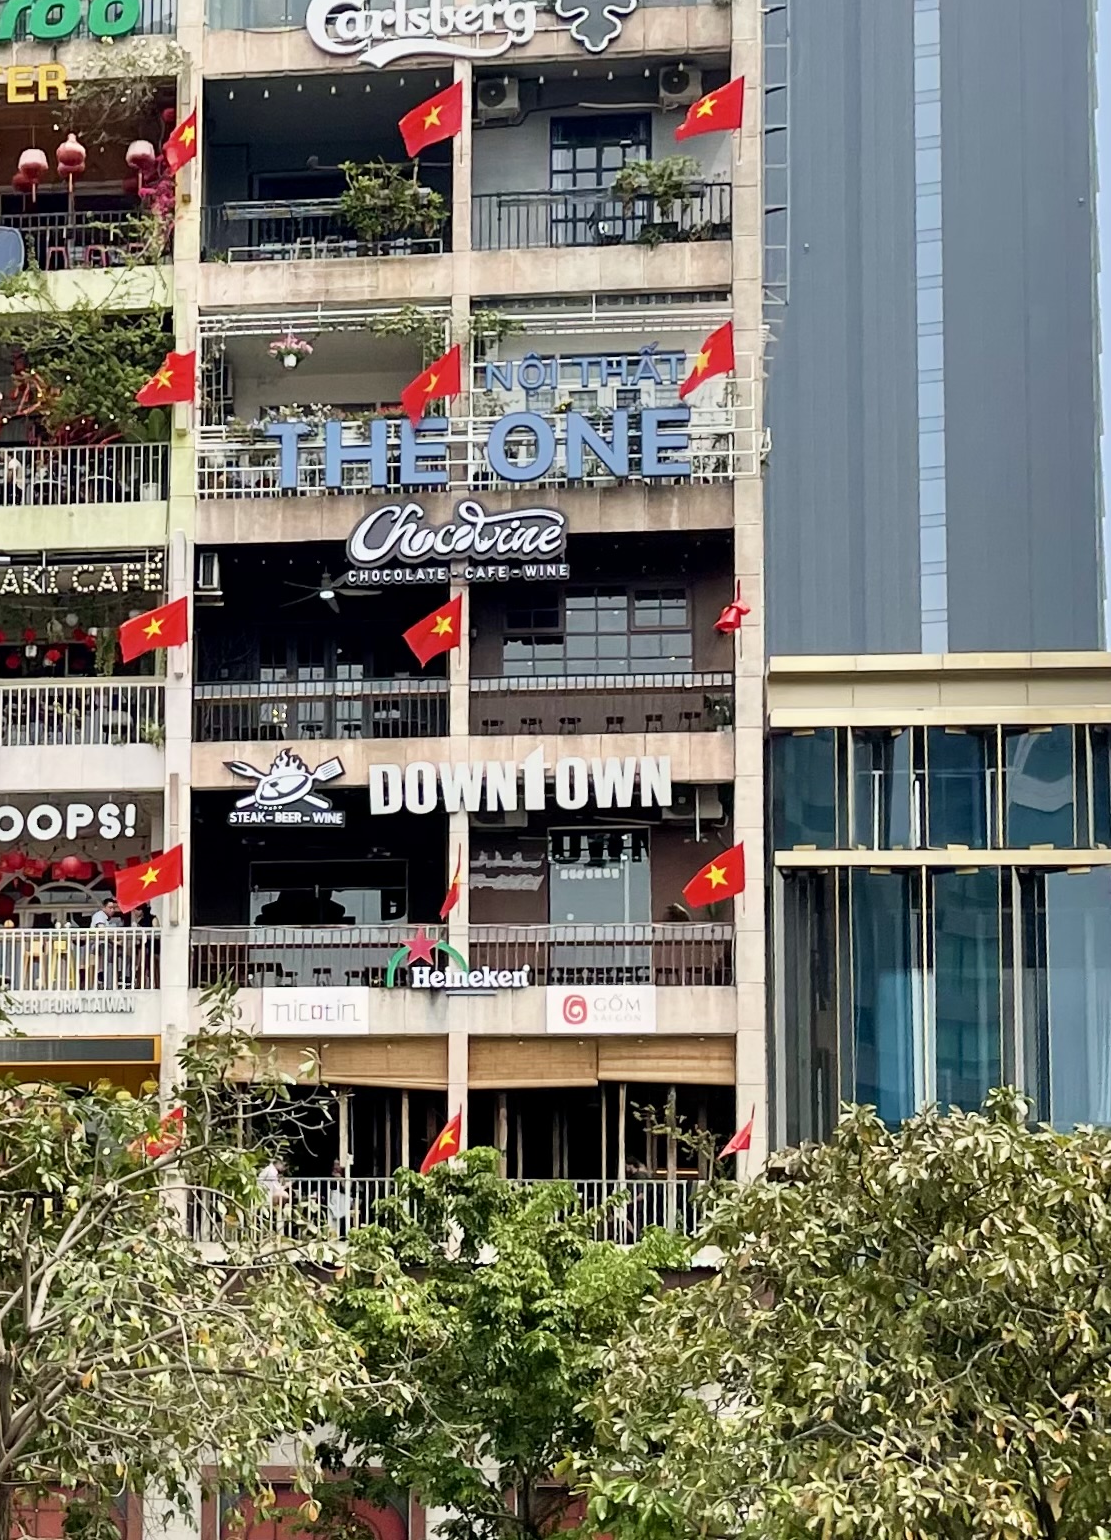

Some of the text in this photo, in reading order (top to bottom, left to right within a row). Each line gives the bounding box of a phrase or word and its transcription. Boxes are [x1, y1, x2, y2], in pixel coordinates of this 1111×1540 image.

[572, 341, 687, 387] THẤT
[266, 407, 690, 490] THE ONE
[348, 568, 446, 583] CHOCOLATE
[464, 566, 507, 579] CAFE
[524, 564, 569, 578] WINE
[230, 811, 266, 824] STEAK
[275, 811, 302, 824] BEER
[313, 812, 344, 824] WINE
[411, 964, 530, 988] Heineken
[271, 999, 361, 1022] nicotin
